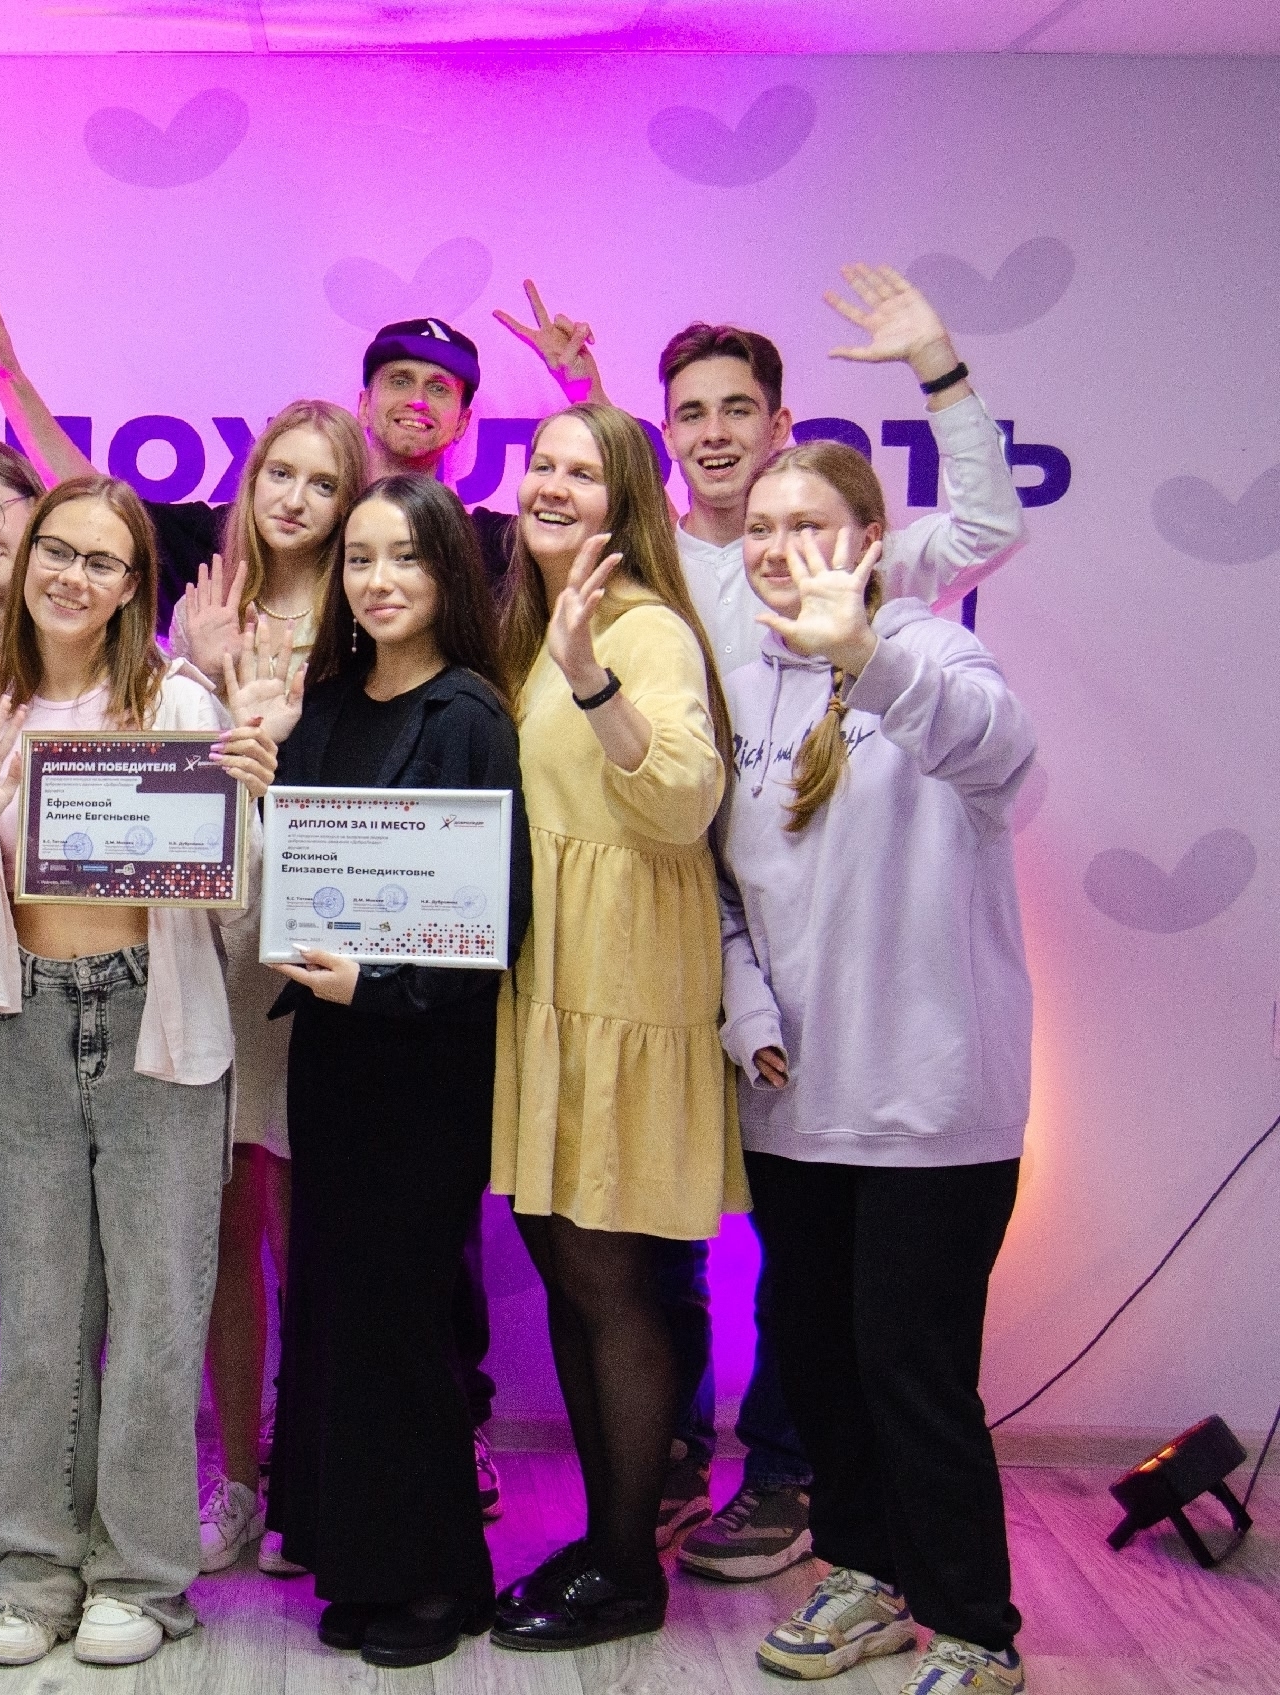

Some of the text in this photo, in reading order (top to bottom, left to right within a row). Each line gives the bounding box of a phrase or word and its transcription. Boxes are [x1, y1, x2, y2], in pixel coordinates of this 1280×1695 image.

[42, 762, 177, 773] ДИПЛОМ ПОБЕДИТЕЛЯ
[47, 798, 112, 809] Ефремовой
[46, 811, 151, 822] Алине Евгеньевне
[288, 819, 426, 831] ДИПЛОМ ЗА II МЕСТО
[281, 851, 338, 861] Фокиной
[281, 864, 436, 878] Елизавете Венедиктовне
